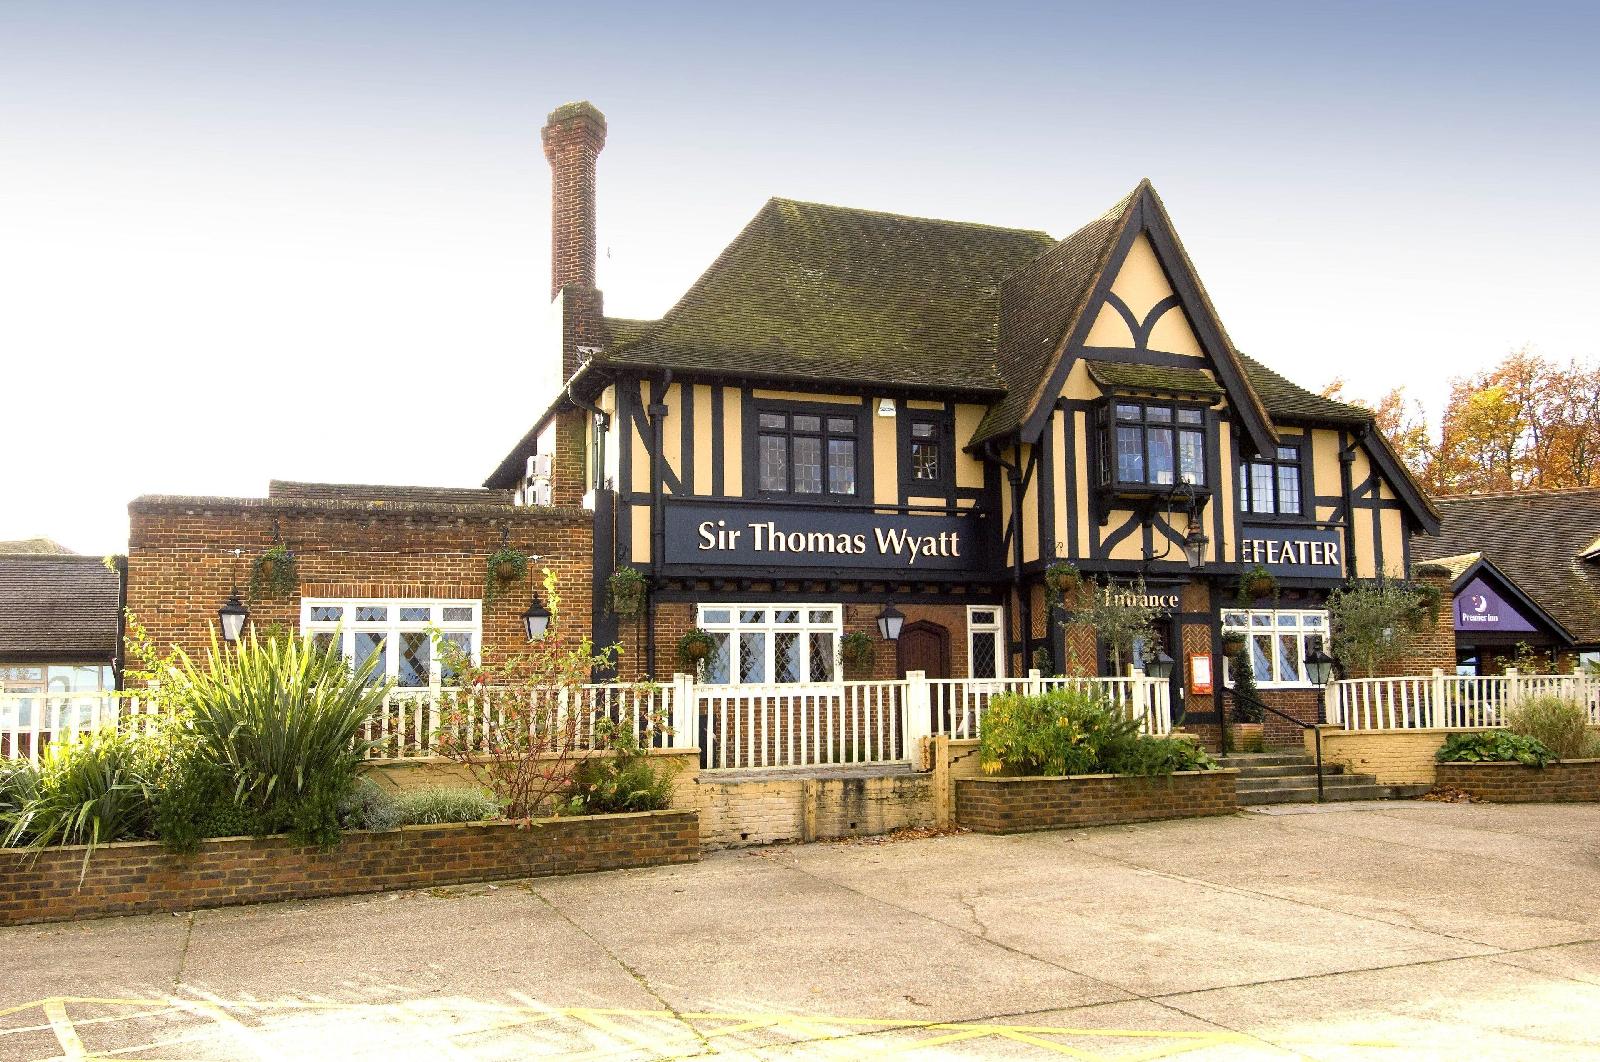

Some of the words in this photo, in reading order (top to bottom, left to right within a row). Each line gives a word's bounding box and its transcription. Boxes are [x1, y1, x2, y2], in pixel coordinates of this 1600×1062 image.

[698, 521, 741, 551] Sir
[748, 522, 866, 555] Thomas
[874, 527, 961, 565] Wyatt
[1462, 612, 1487, 622] Premier
[1487, 613, 1499, 622] Inn
